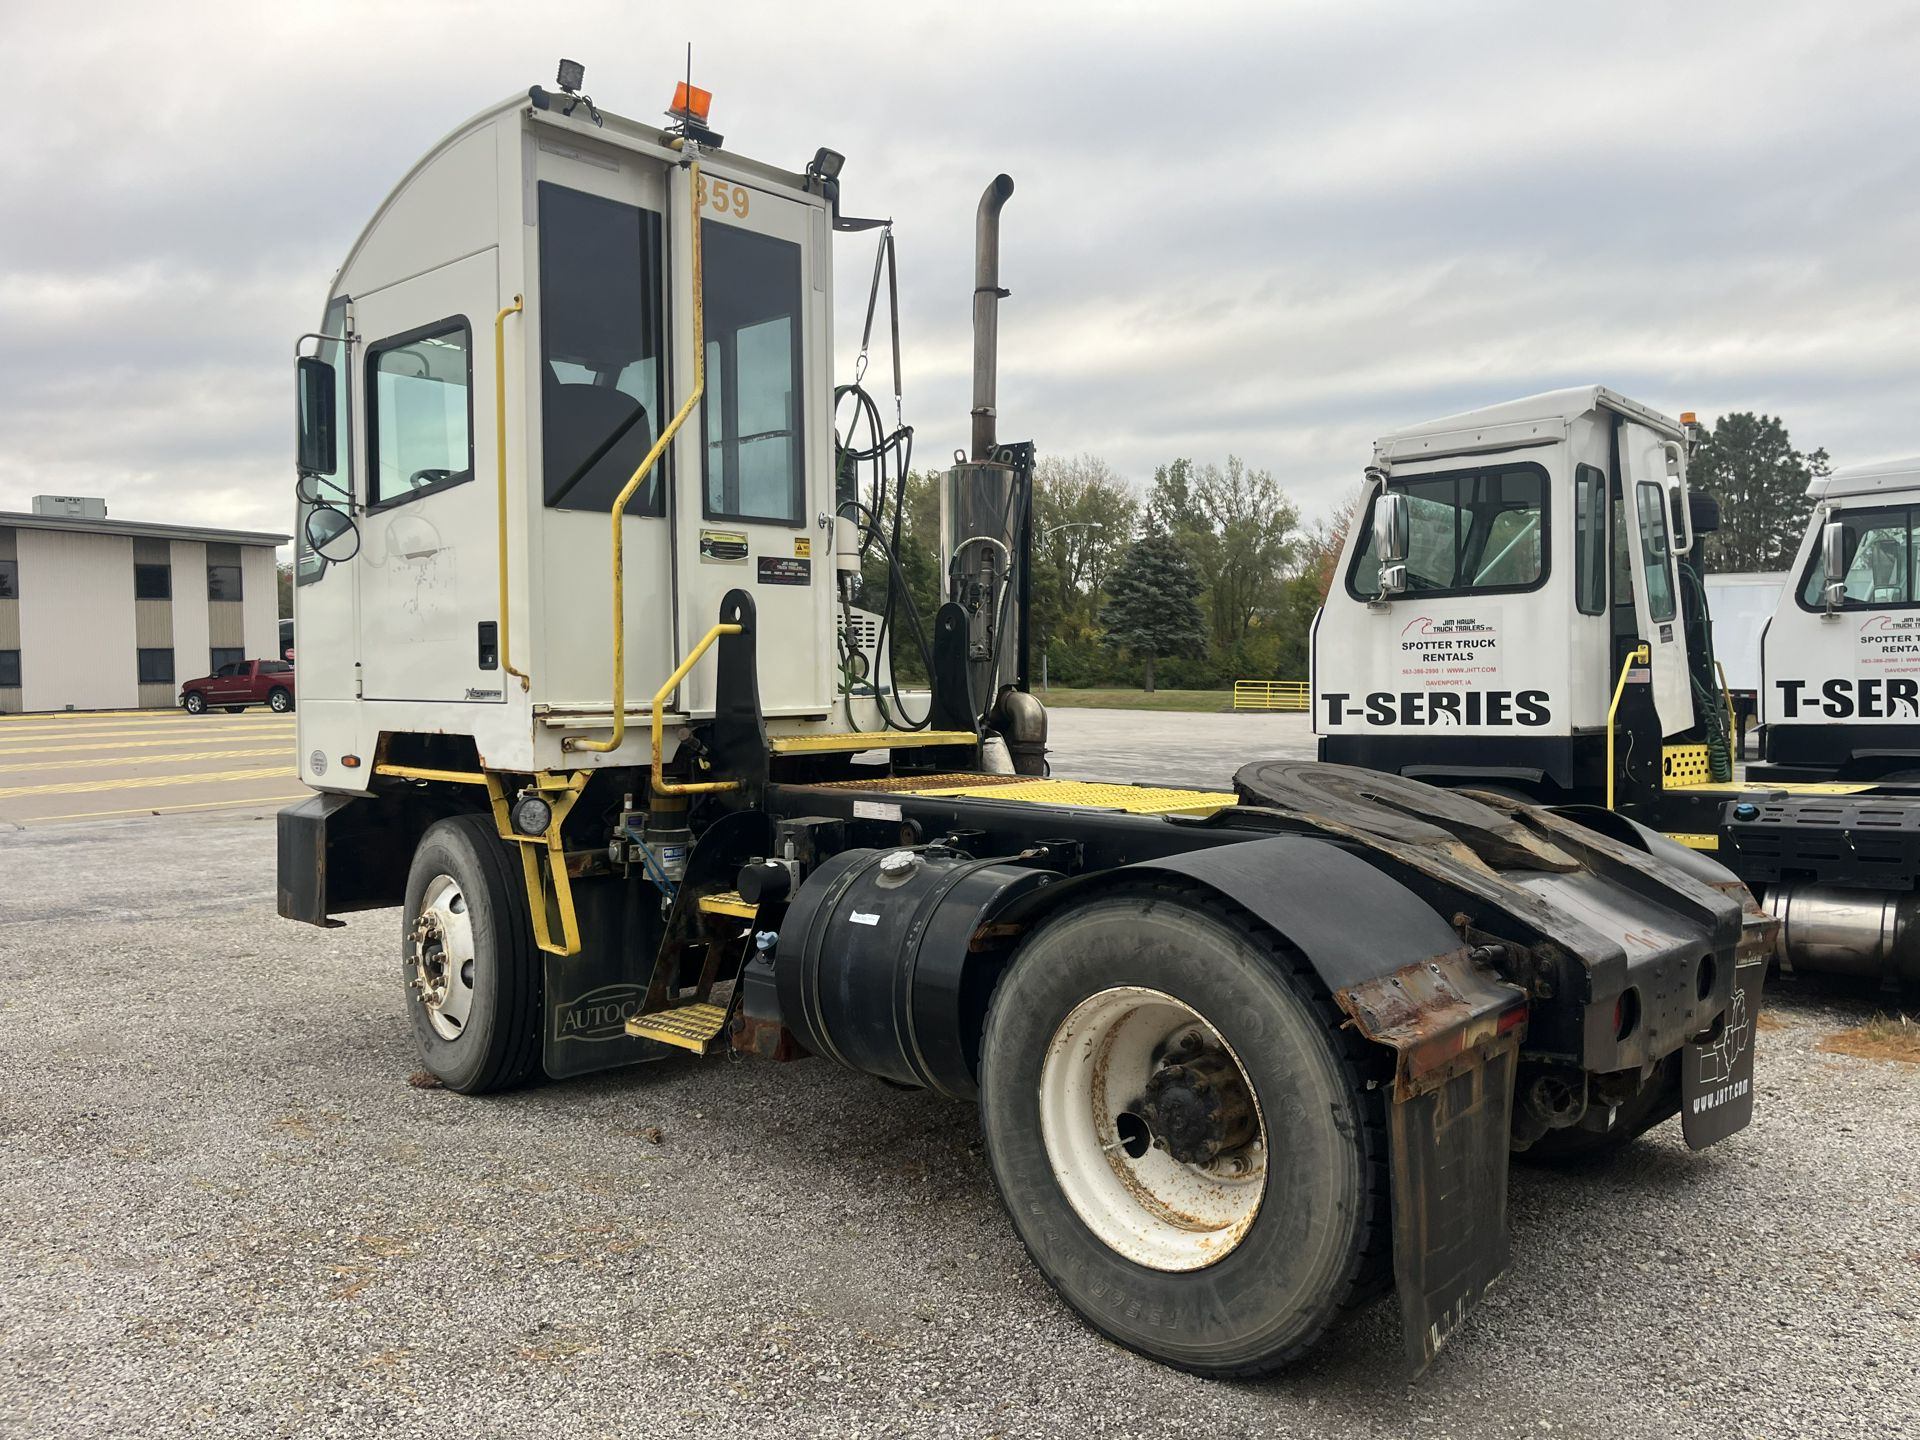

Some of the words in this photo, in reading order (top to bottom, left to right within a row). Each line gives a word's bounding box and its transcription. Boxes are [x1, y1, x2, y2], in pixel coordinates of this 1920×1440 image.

[1455, 624, 1485, 632] TRAILERS
[1401, 640, 1453, 651] SPOTTER
[1456, 638, 1496, 649] TRUCK
[1860, 635, 1912, 644] SPOTTER
[1422, 652, 1474, 662] RENTALS
[1321, 690, 1551, 727] T-SERIES
[562, 1000, 637, 1032] AUTOC
